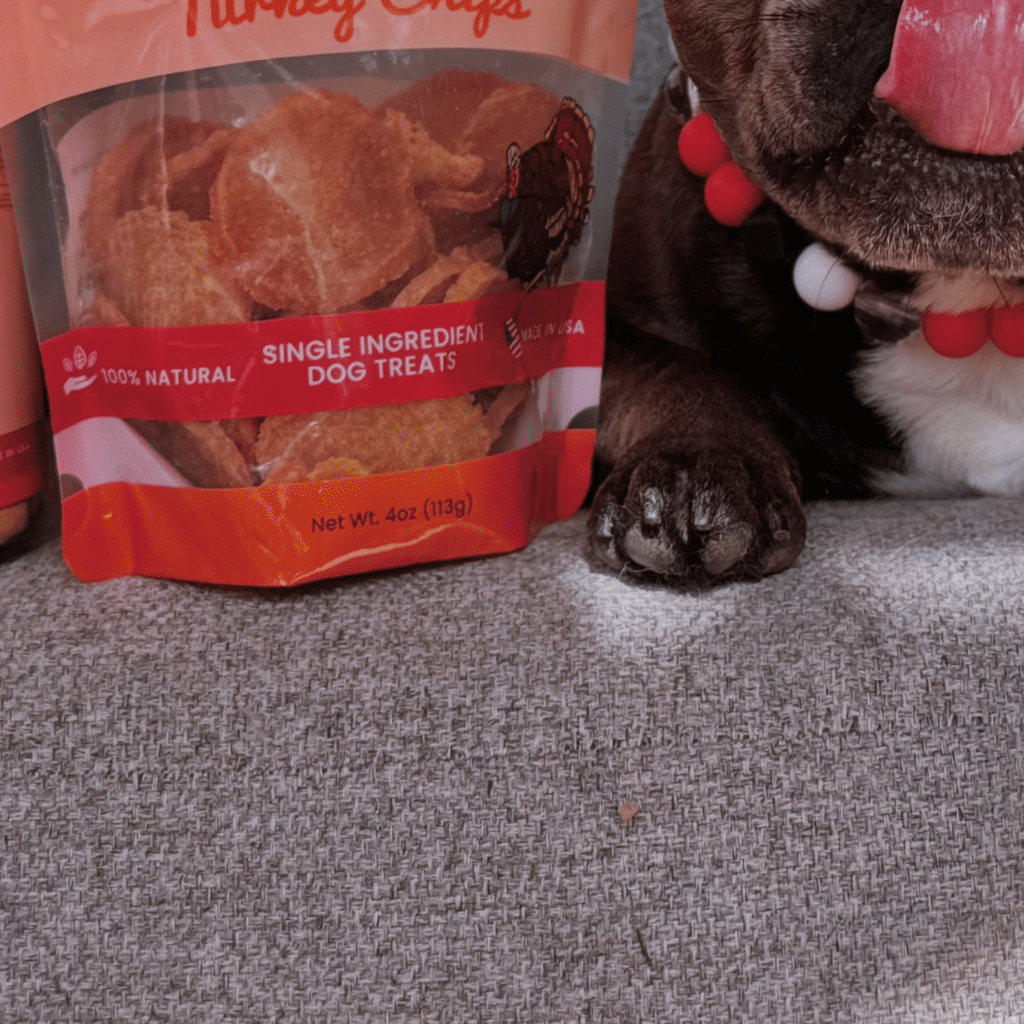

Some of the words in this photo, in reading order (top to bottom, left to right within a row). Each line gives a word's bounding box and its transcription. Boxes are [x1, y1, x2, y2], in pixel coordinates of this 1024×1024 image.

[262, 336, 352, 366] SINGLE
[359, 321, 485, 356] INGREDIENT
[100, 367, 142, 386] 100%
[145, 365, 236, 386] NATURAL
[307, 361, 367, 387] DOG
[374, 350, 458, 379] TREATS
[311, 514, 345, 533] Net
[349, 509, 381, 528] Wt.
[385, 506, 418, 523] 4oz
[423, 490, 474, 522] (113g)
